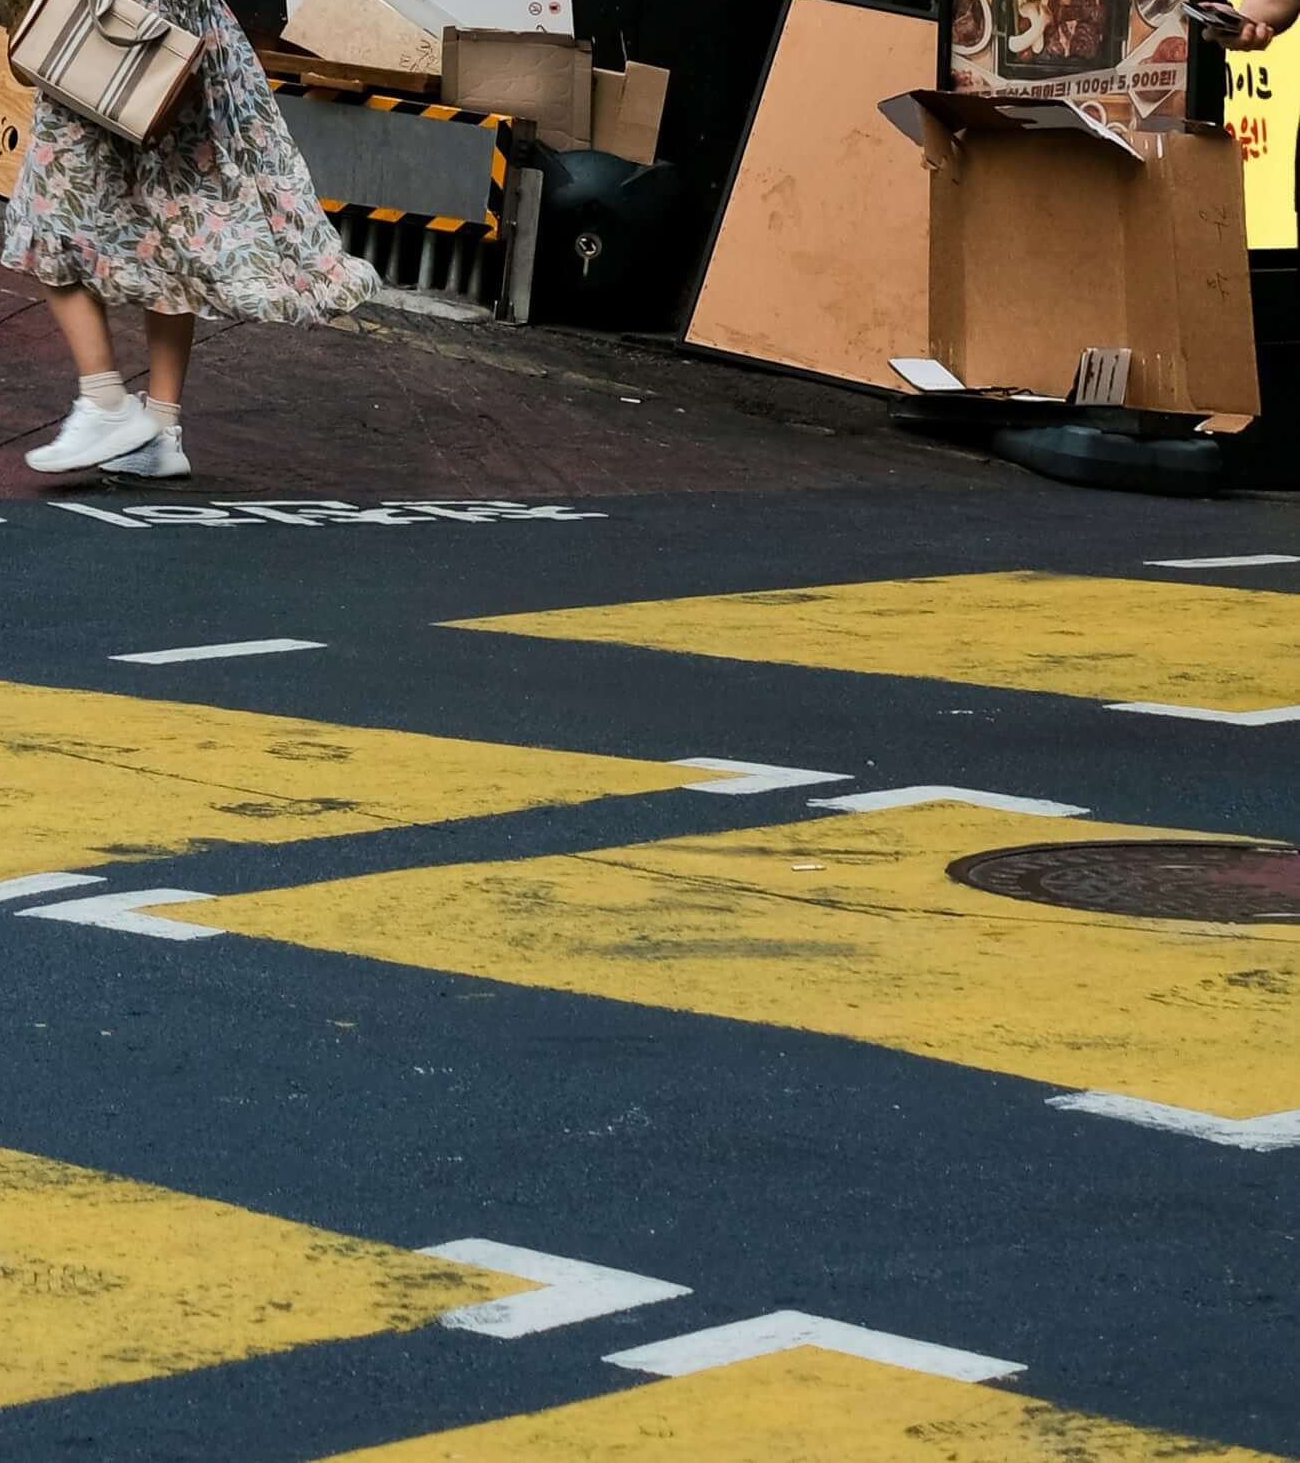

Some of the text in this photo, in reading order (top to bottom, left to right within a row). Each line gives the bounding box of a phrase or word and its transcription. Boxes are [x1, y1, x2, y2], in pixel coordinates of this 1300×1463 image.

[1074, 68, 1178, 96] 100g! 5,900원!
[47, 498, 611, 530] 천천히
